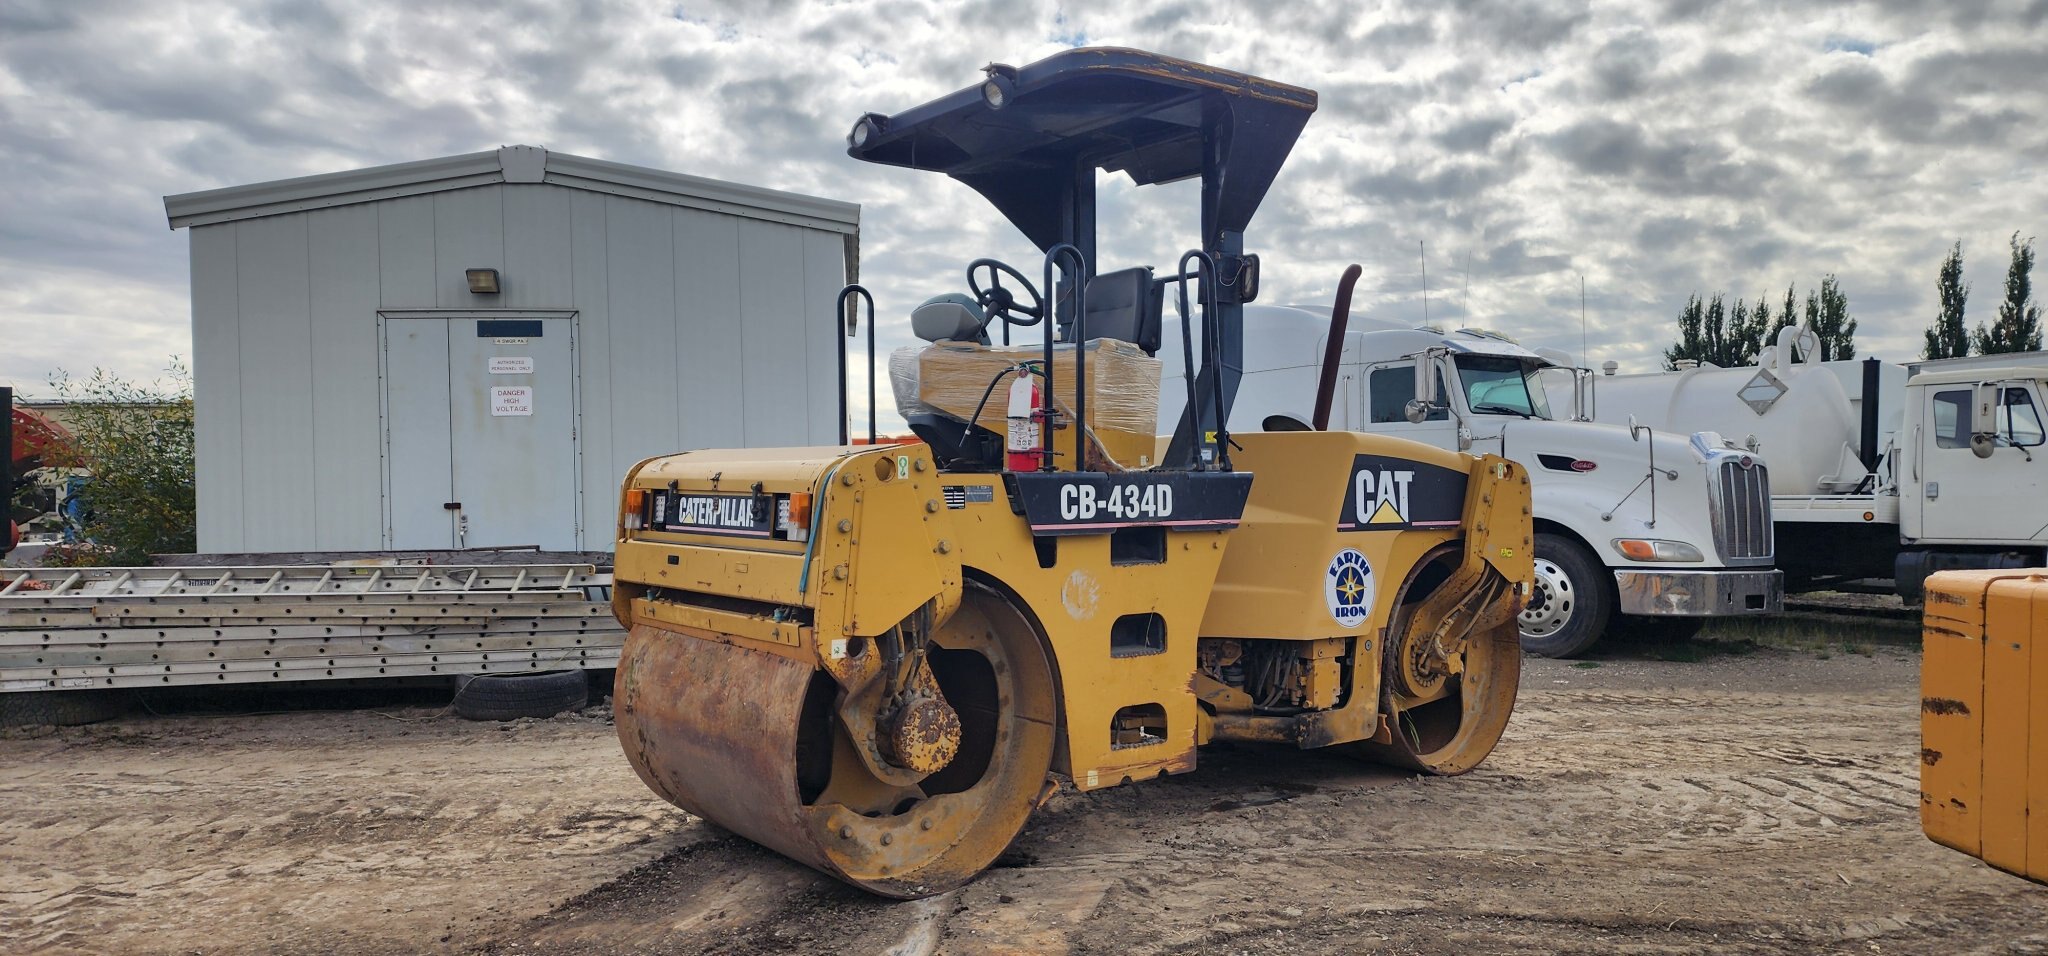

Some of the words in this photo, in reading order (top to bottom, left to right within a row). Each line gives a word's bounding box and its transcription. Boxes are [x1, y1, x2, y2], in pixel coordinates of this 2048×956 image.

[679, 496, 754, 527] CATERPILLAR
[1060, 483, 1173, 520] CB-434D
[1355, 469, 1413, 524] CAT
[1329, 551, 1370, 577] EARTH
[1335, 606, 1367, 618] IRON
